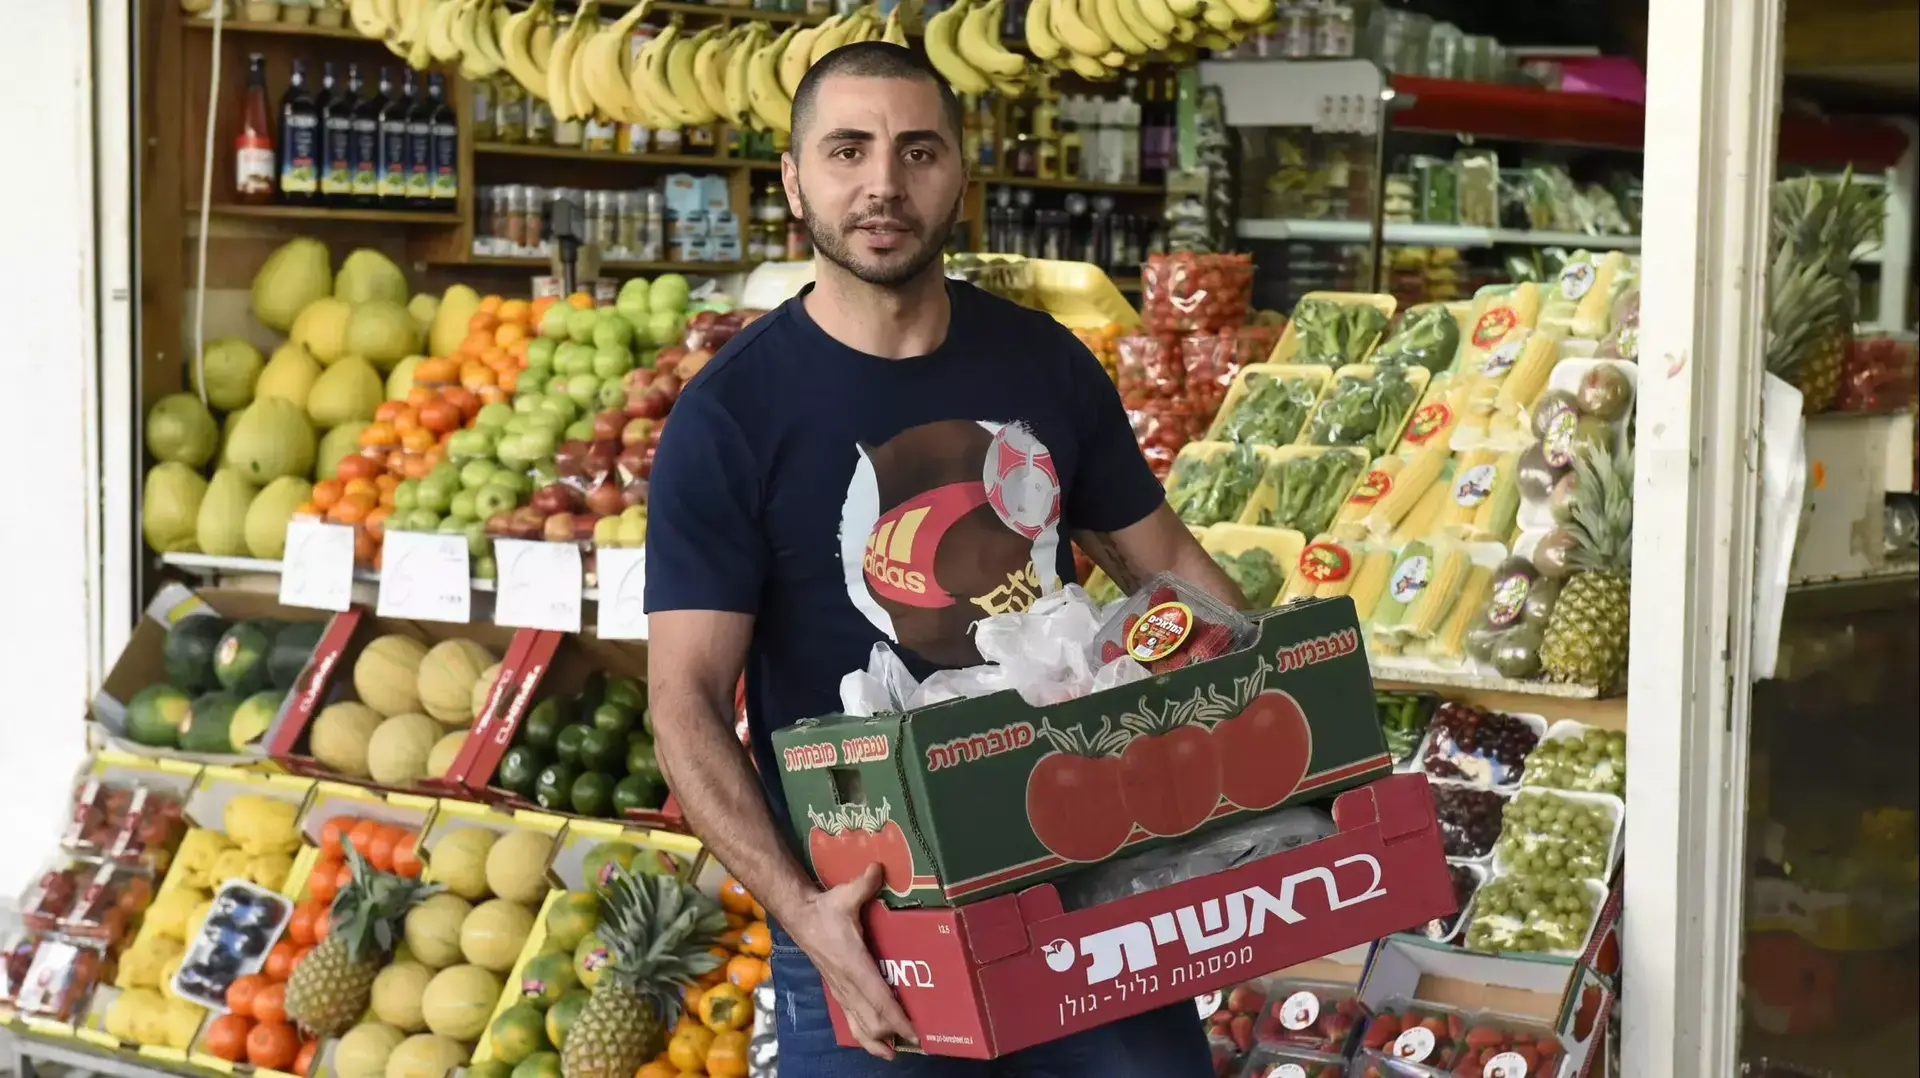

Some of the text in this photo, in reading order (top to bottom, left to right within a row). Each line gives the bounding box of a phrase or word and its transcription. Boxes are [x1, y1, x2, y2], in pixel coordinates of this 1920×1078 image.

[864, 550, 926, 594] didas
[1276, 627, 1358, 673] עגבניות
[784, 735, 889, 771] עגבניות מובחרות
[926, 721, 1035, 771] מובחרות
[1080, 853, 1387, 985] בראשית
[879, 959, 934, 987] בראש
[1171, 945, 1253, 986] מפסגות
